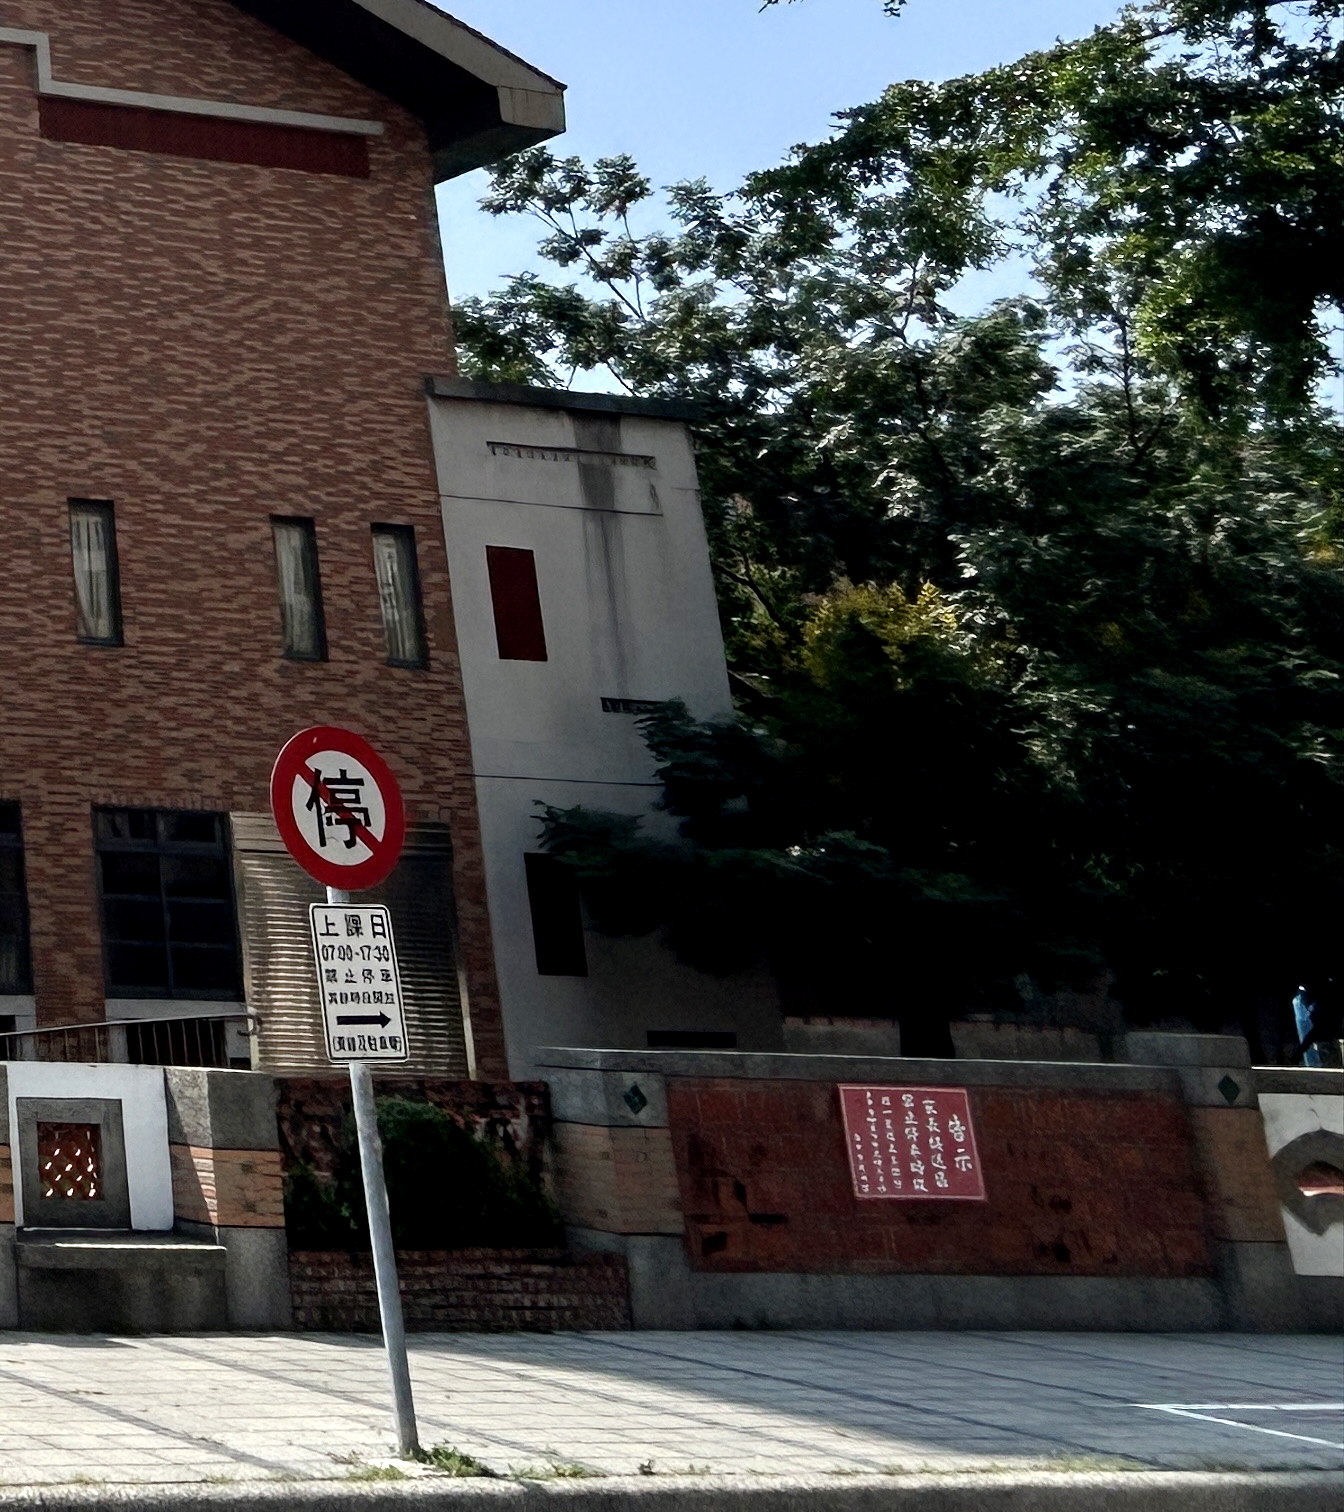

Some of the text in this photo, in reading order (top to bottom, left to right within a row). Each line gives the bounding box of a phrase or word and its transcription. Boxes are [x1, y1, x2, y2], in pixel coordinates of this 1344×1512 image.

[305, 768, 372, 849] 停
[319, 913, 387, 938] 上課日
